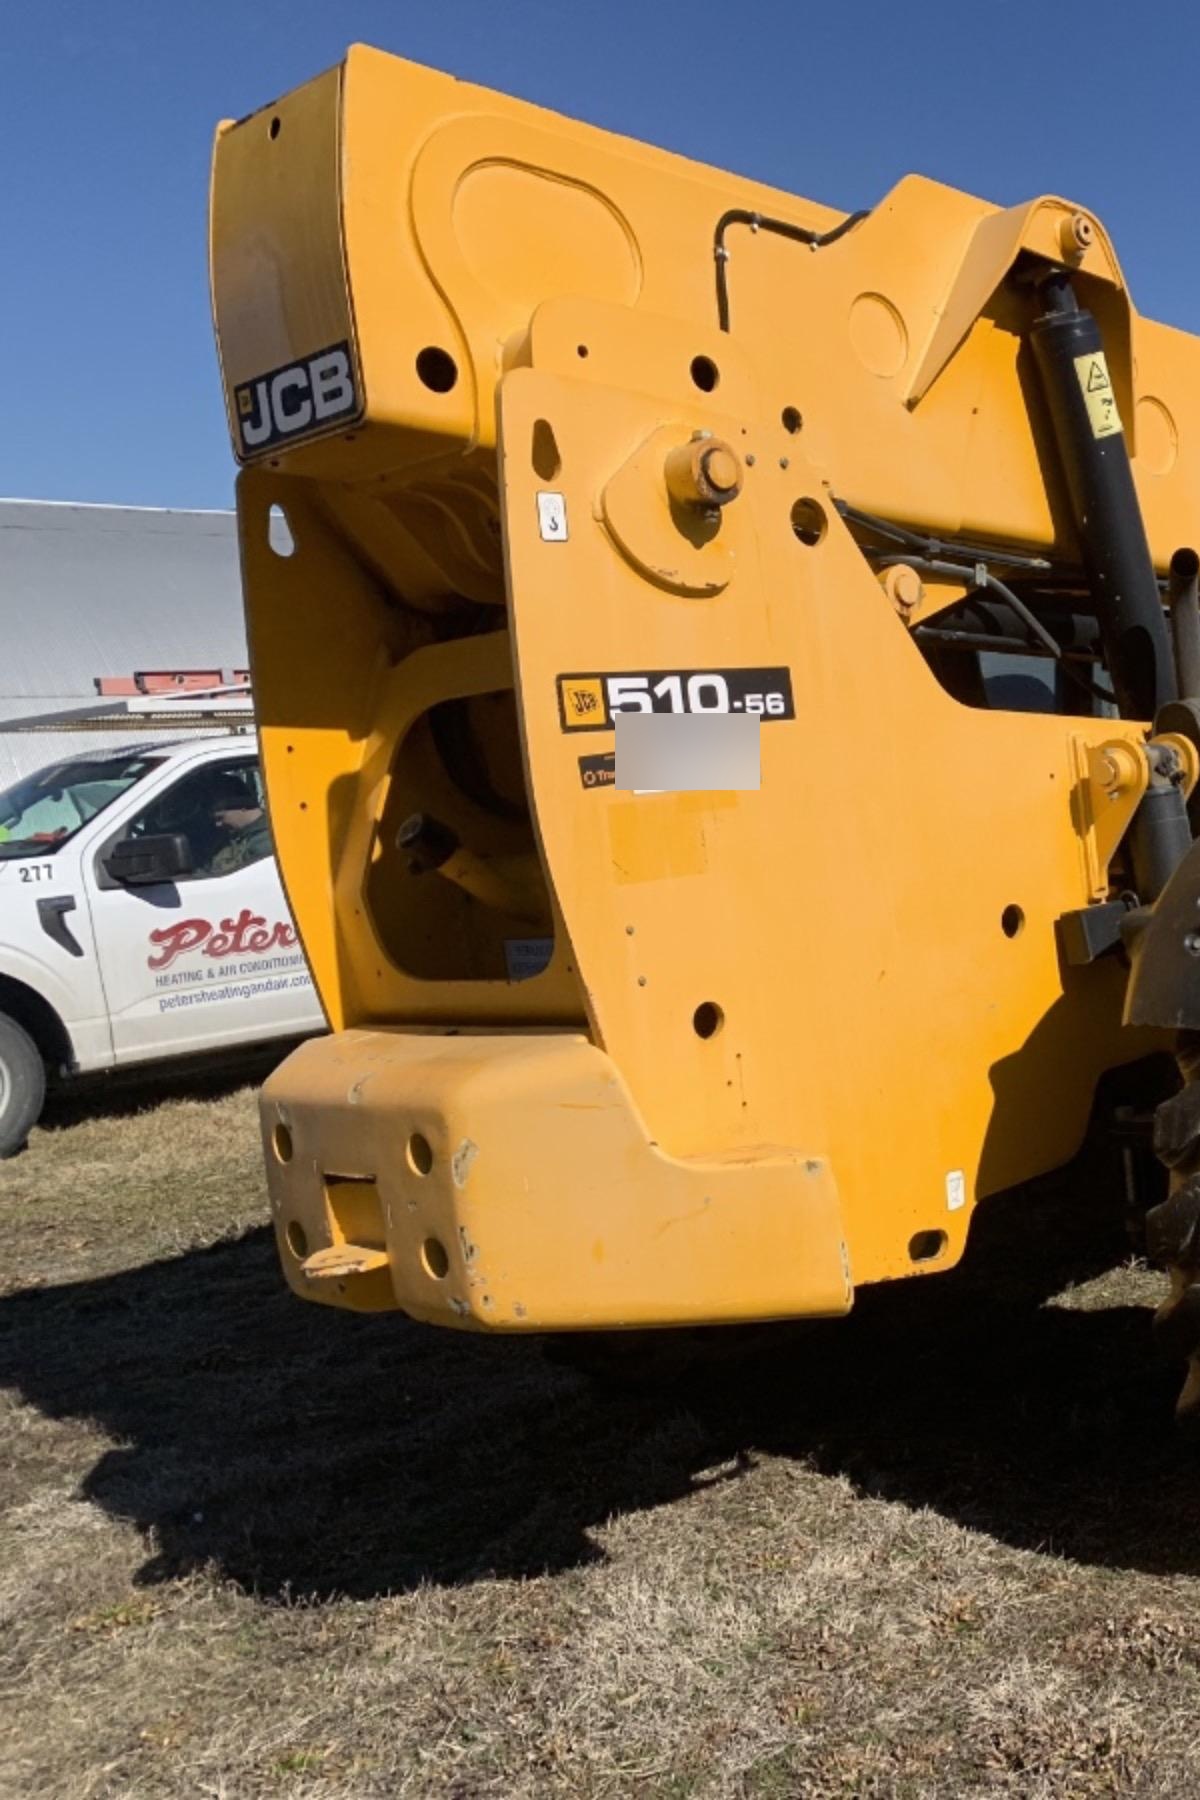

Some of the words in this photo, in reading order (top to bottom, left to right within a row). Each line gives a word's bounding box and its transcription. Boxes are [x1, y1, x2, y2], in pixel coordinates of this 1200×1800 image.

[242, 351, 353, 446] JCB
[606, 674, 785, 720] 510-56
[19, 864, 53, 882] 277
[147, 909, 301, 971] Peter
[155, 969, 204, 987] HEATING
[207, 967, 216, 980] &
[218, 964, 237, 977] AIR
[239, 954, 304, 973] CONDITIONI
